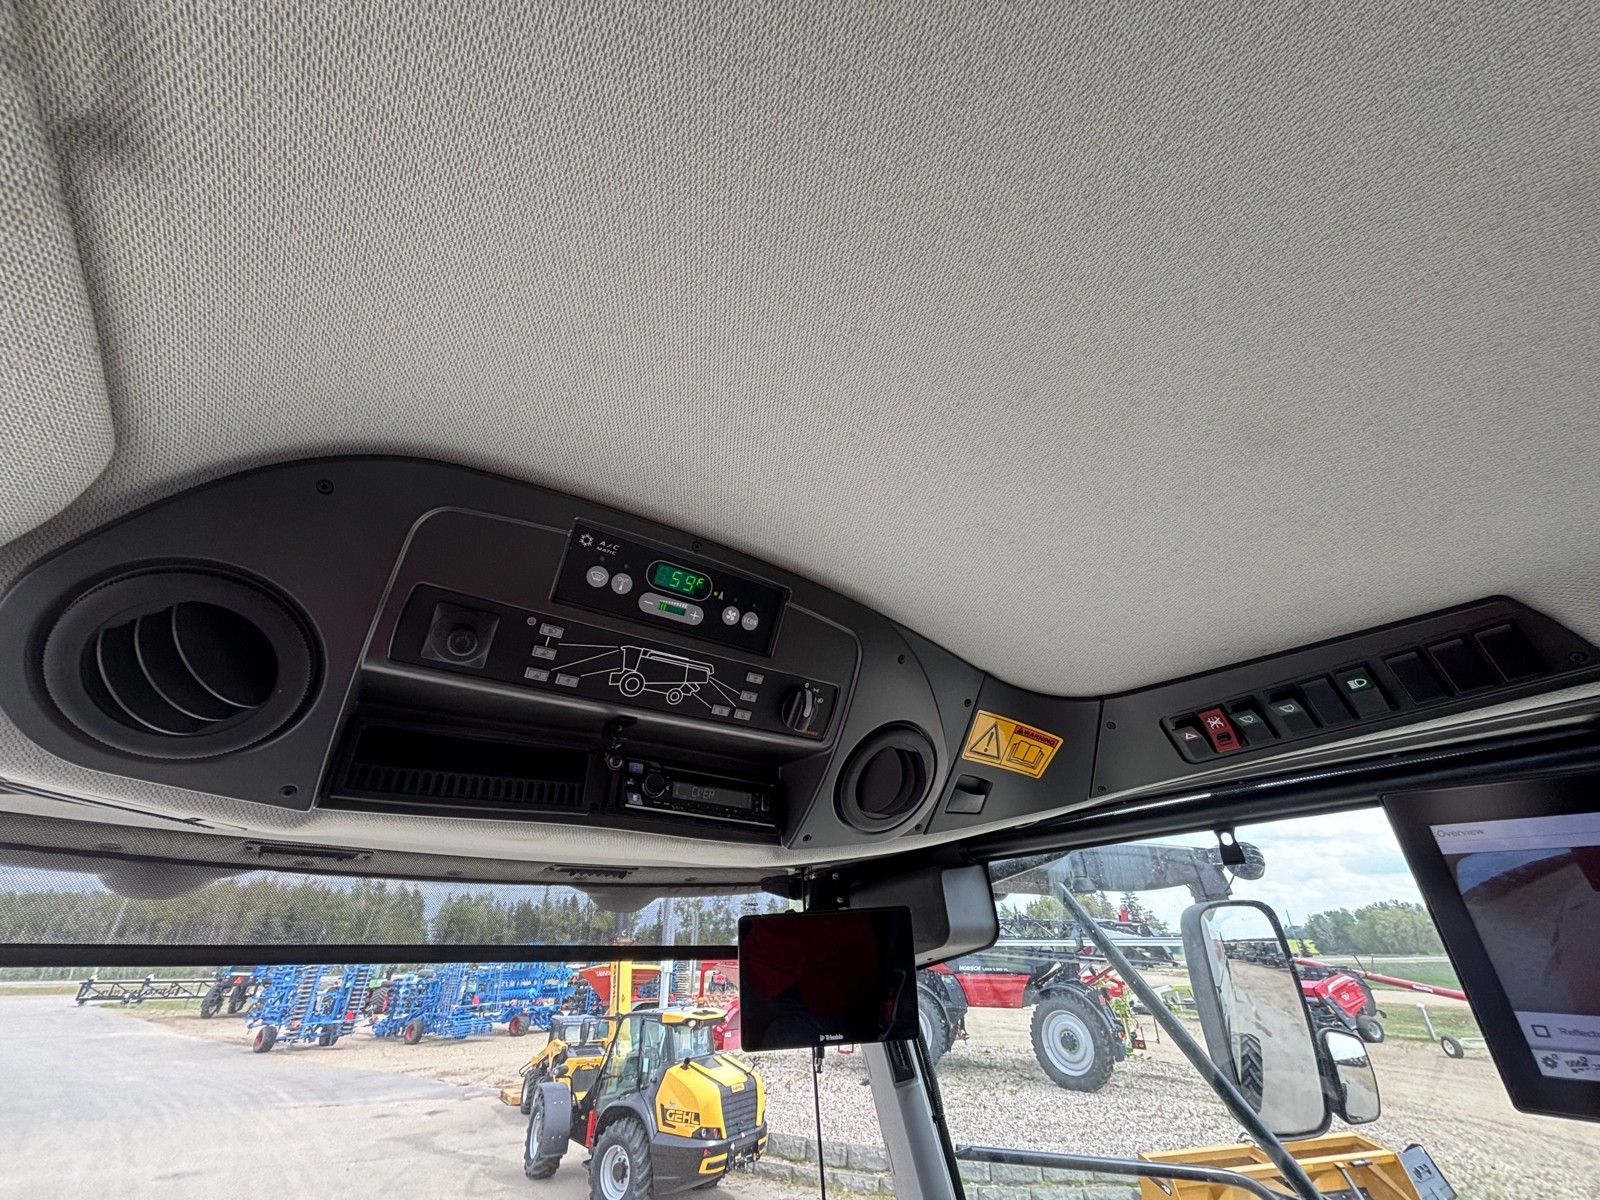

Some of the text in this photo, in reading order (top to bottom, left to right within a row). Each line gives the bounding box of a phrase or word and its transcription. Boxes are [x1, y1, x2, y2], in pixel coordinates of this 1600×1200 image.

[596, 546, 617, 556] MATIC
[599, 541, 620, 551] A/C
[1023, 729, 1056, 746] WARNING
[1436, 829, 1485, 838] Overview
[666, 1109, 700, 1125] GEHL
